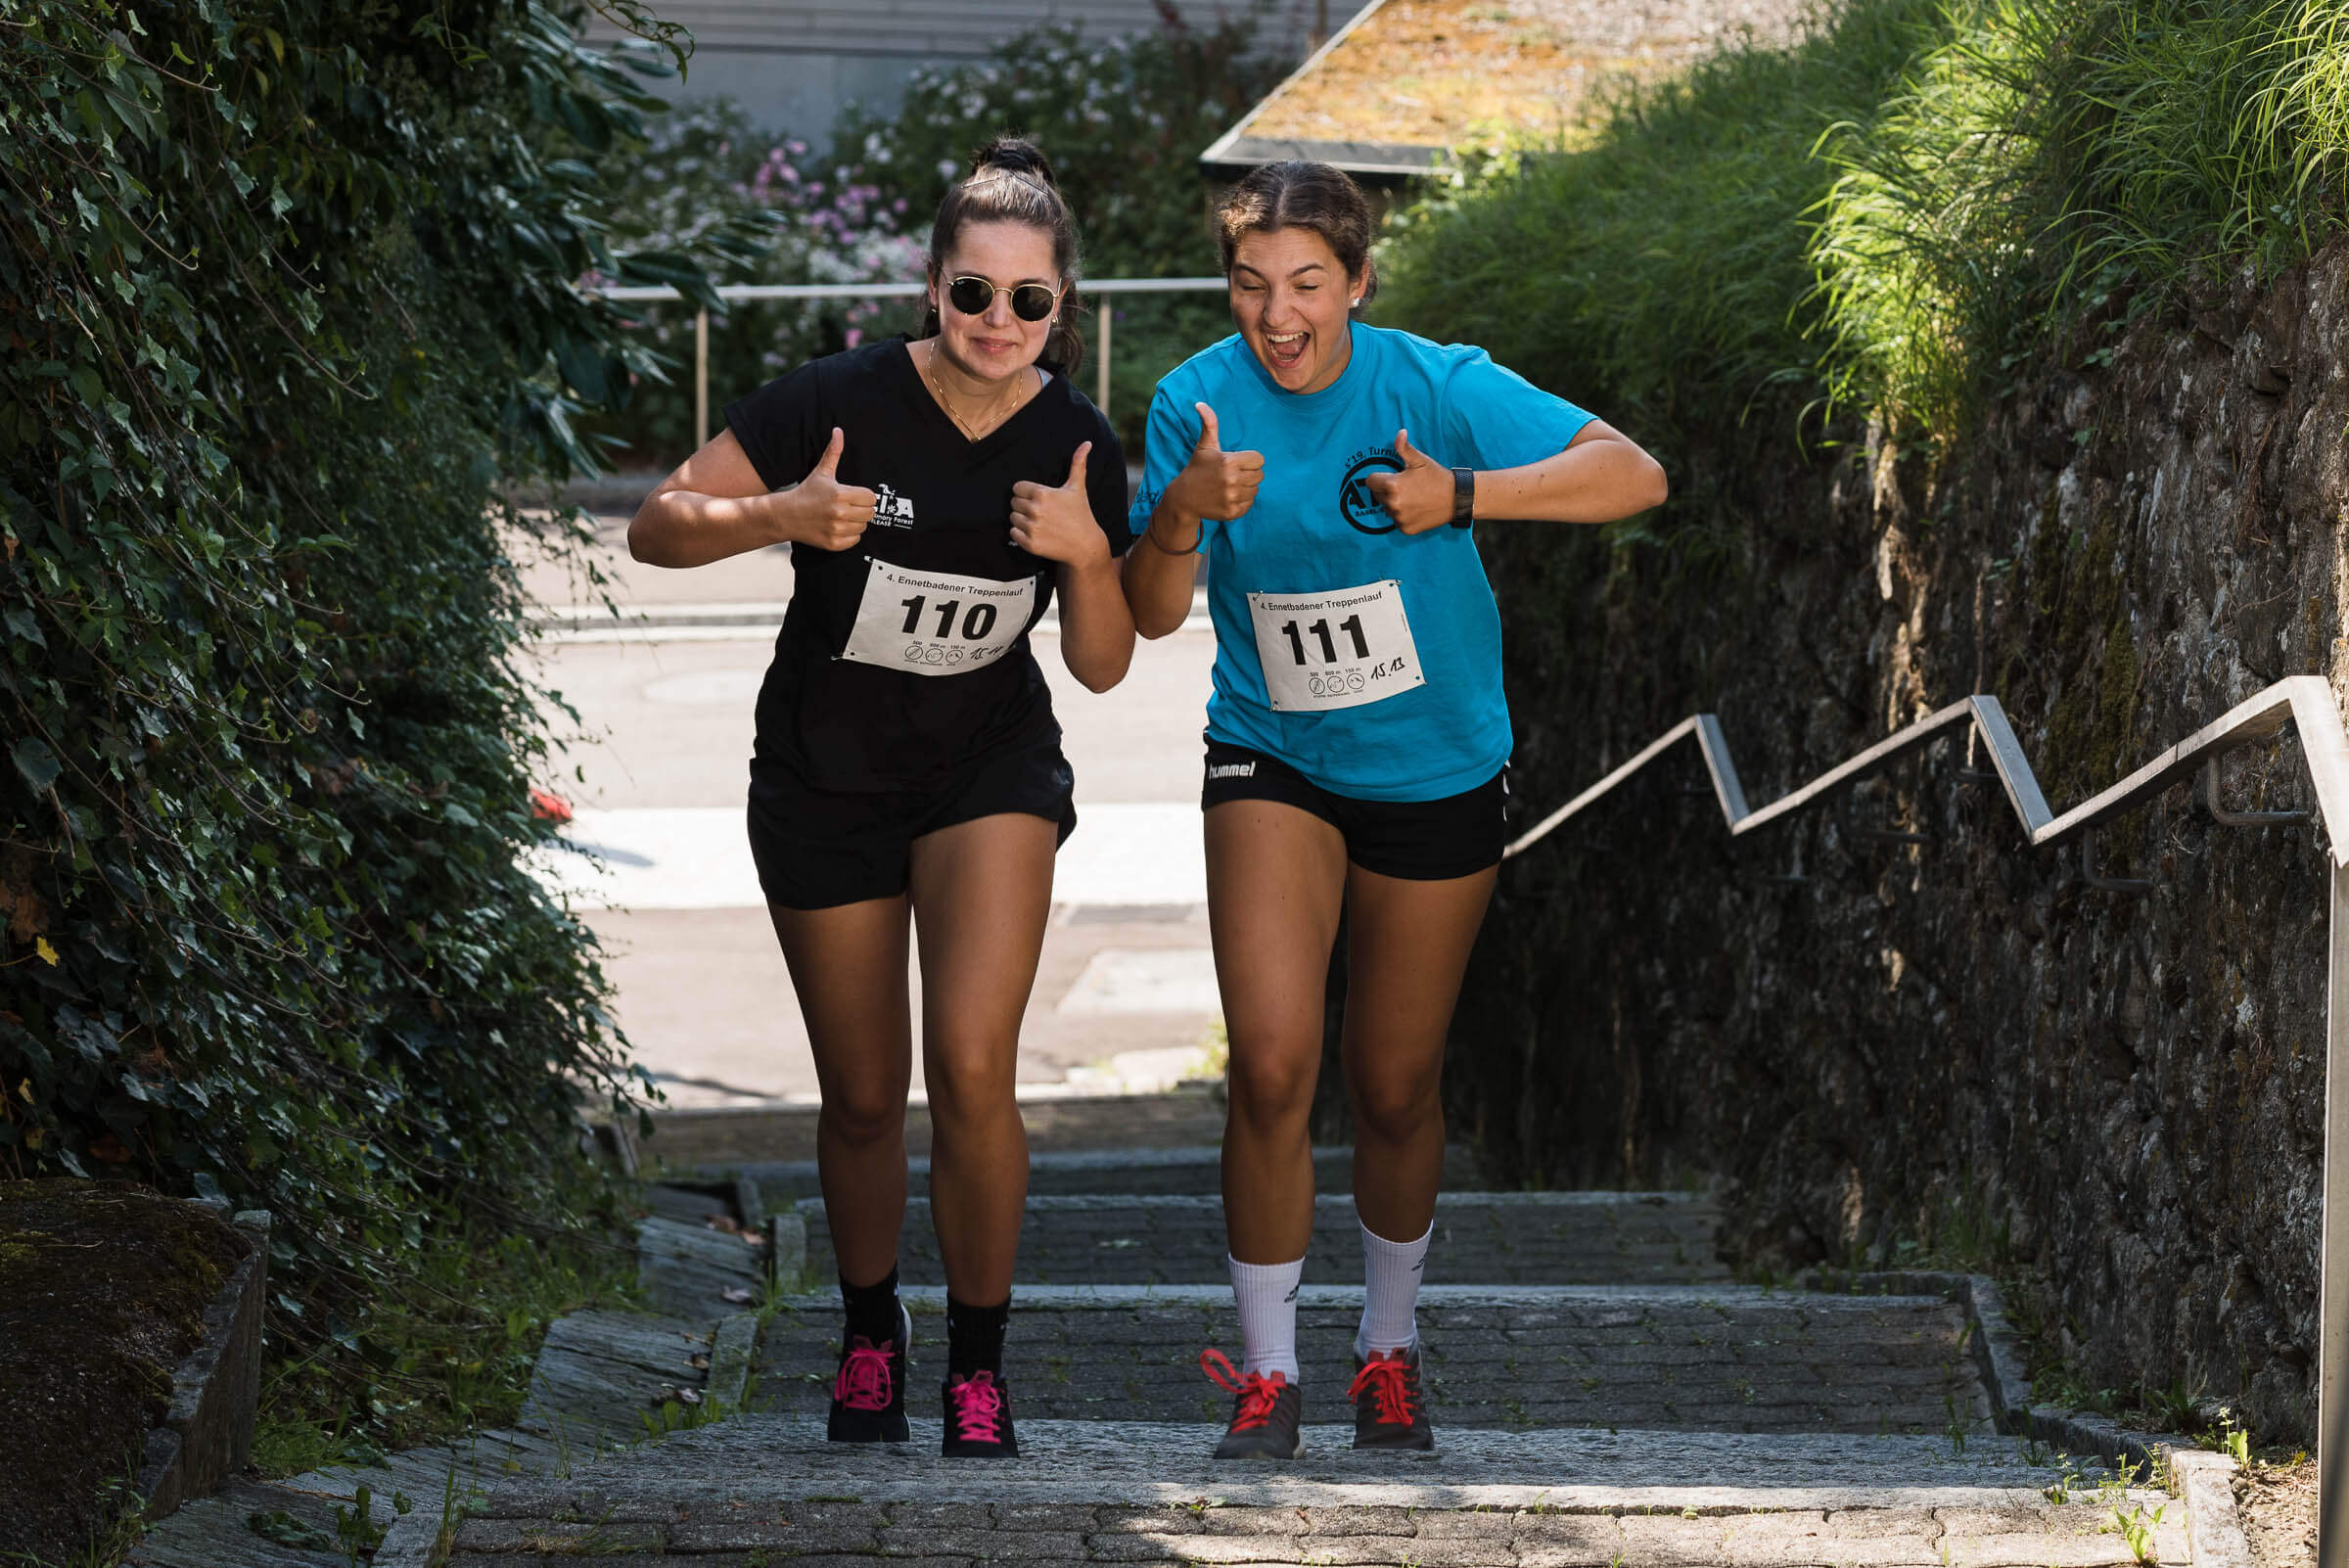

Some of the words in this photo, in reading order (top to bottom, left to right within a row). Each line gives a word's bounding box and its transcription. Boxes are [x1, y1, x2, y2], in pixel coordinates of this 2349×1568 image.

[1368, 445, 1404, 464] Turnie
[887, 574, 896, 582] 4.
[898, 576, 965, 593] Ennetbadener
[968, 586, 1024, 598] Treppenlauf
[1261, 602, 1267, 611] 4.
[1268, 600, 1323, 612] Ennetbadener
[1325, 590, 1383, 609] Treppenlauf
[900, 594, 997, 640] 110
[1281, 614, 1370, 666] 111
[1370, 657, 1405, 680] 15.13
[1209, 760, 1256, 780] hummel
